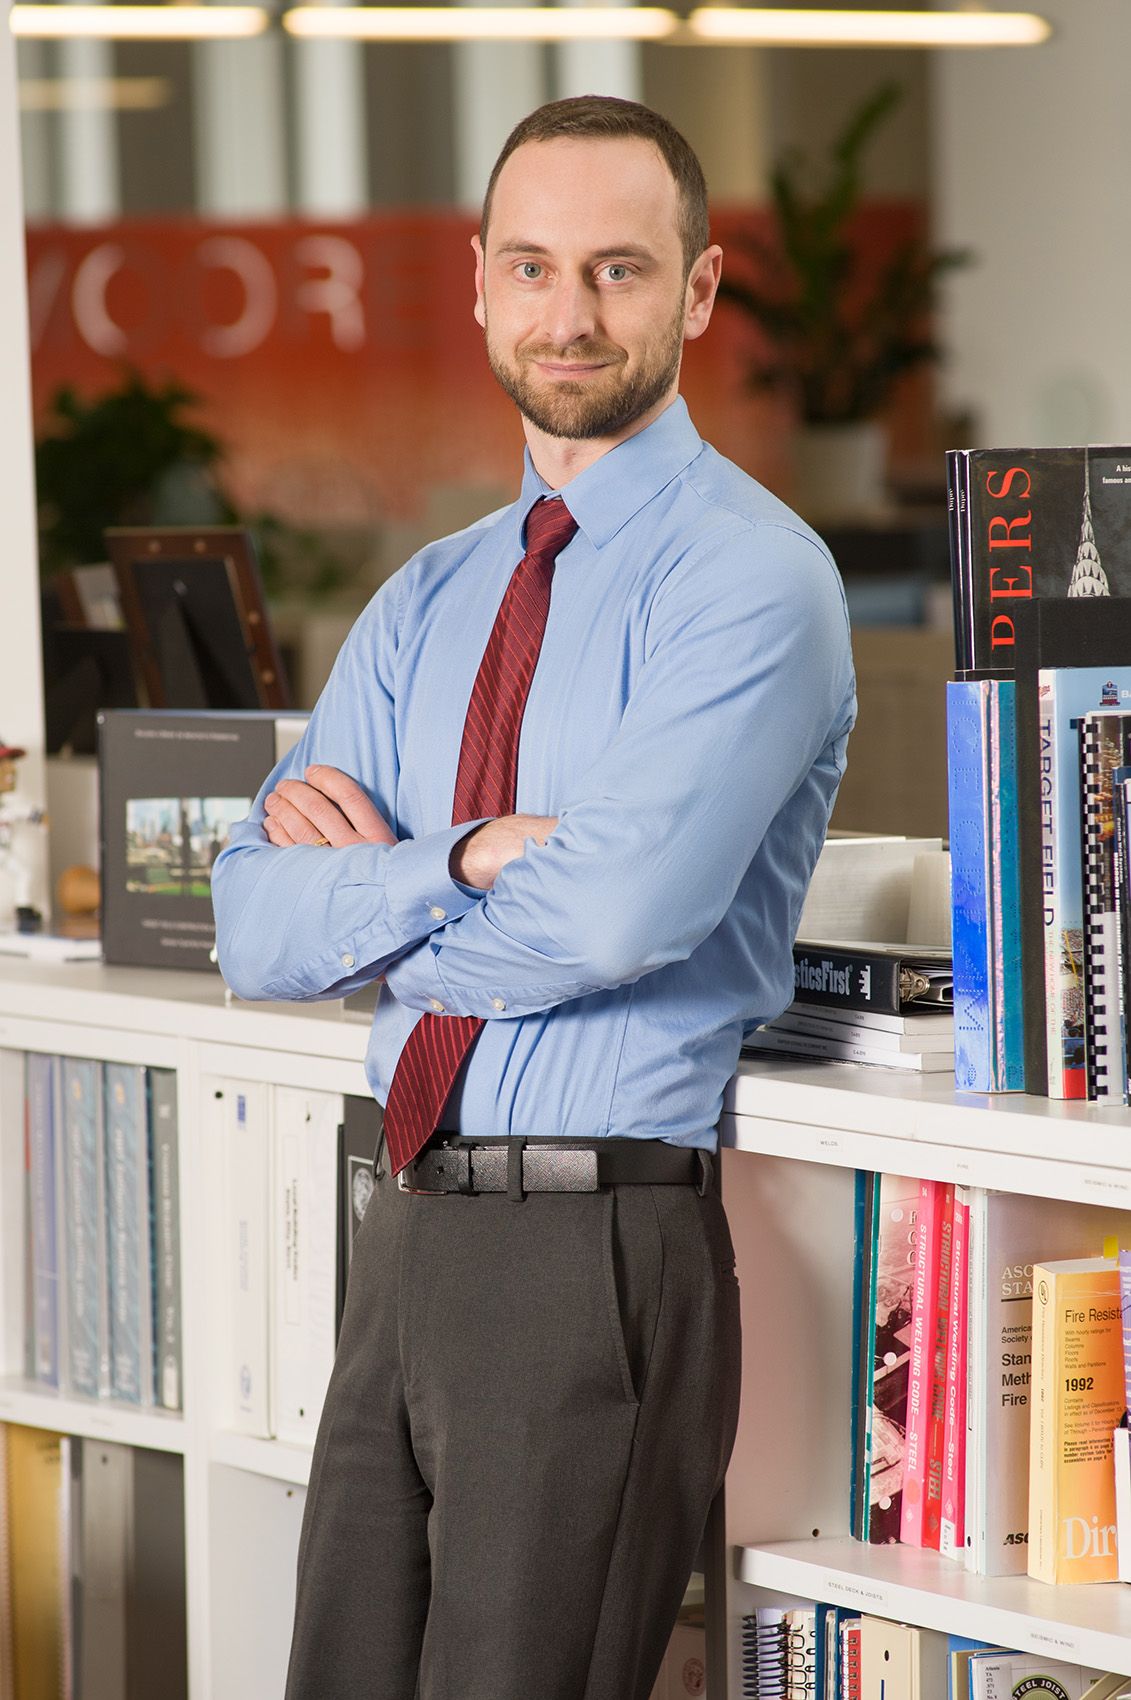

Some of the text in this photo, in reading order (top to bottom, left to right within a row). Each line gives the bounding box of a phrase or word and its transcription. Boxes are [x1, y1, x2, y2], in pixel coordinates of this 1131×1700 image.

[917, 1224, 928, 1312] STRUCTURAL
[938, 1220, 952, 1315] STRUCTURAL
[952, 1239, 962, 1316] Structural
[1065, 1309, 1085, 1323] Fire
[913, 1317, 923, 1376] WELDING
[933, 1317, 947, 1384] WELDING
[949, 1317, 960, 1383] Welding
[1001, 1335, 1029, 1344] Society
[1001, 1393, 1027, 1407] Fire
[1065, 1377, 1094, 1391] 1992
[927, 1459, 943, 1501] STEEL
[1063, 1515, 1118, 1560] Dir
[828, 1581, 844, 1591] STEEL
[845, 1586, 859, 1594] DECK
[865, 1591, 883, 1601] JOISTS
